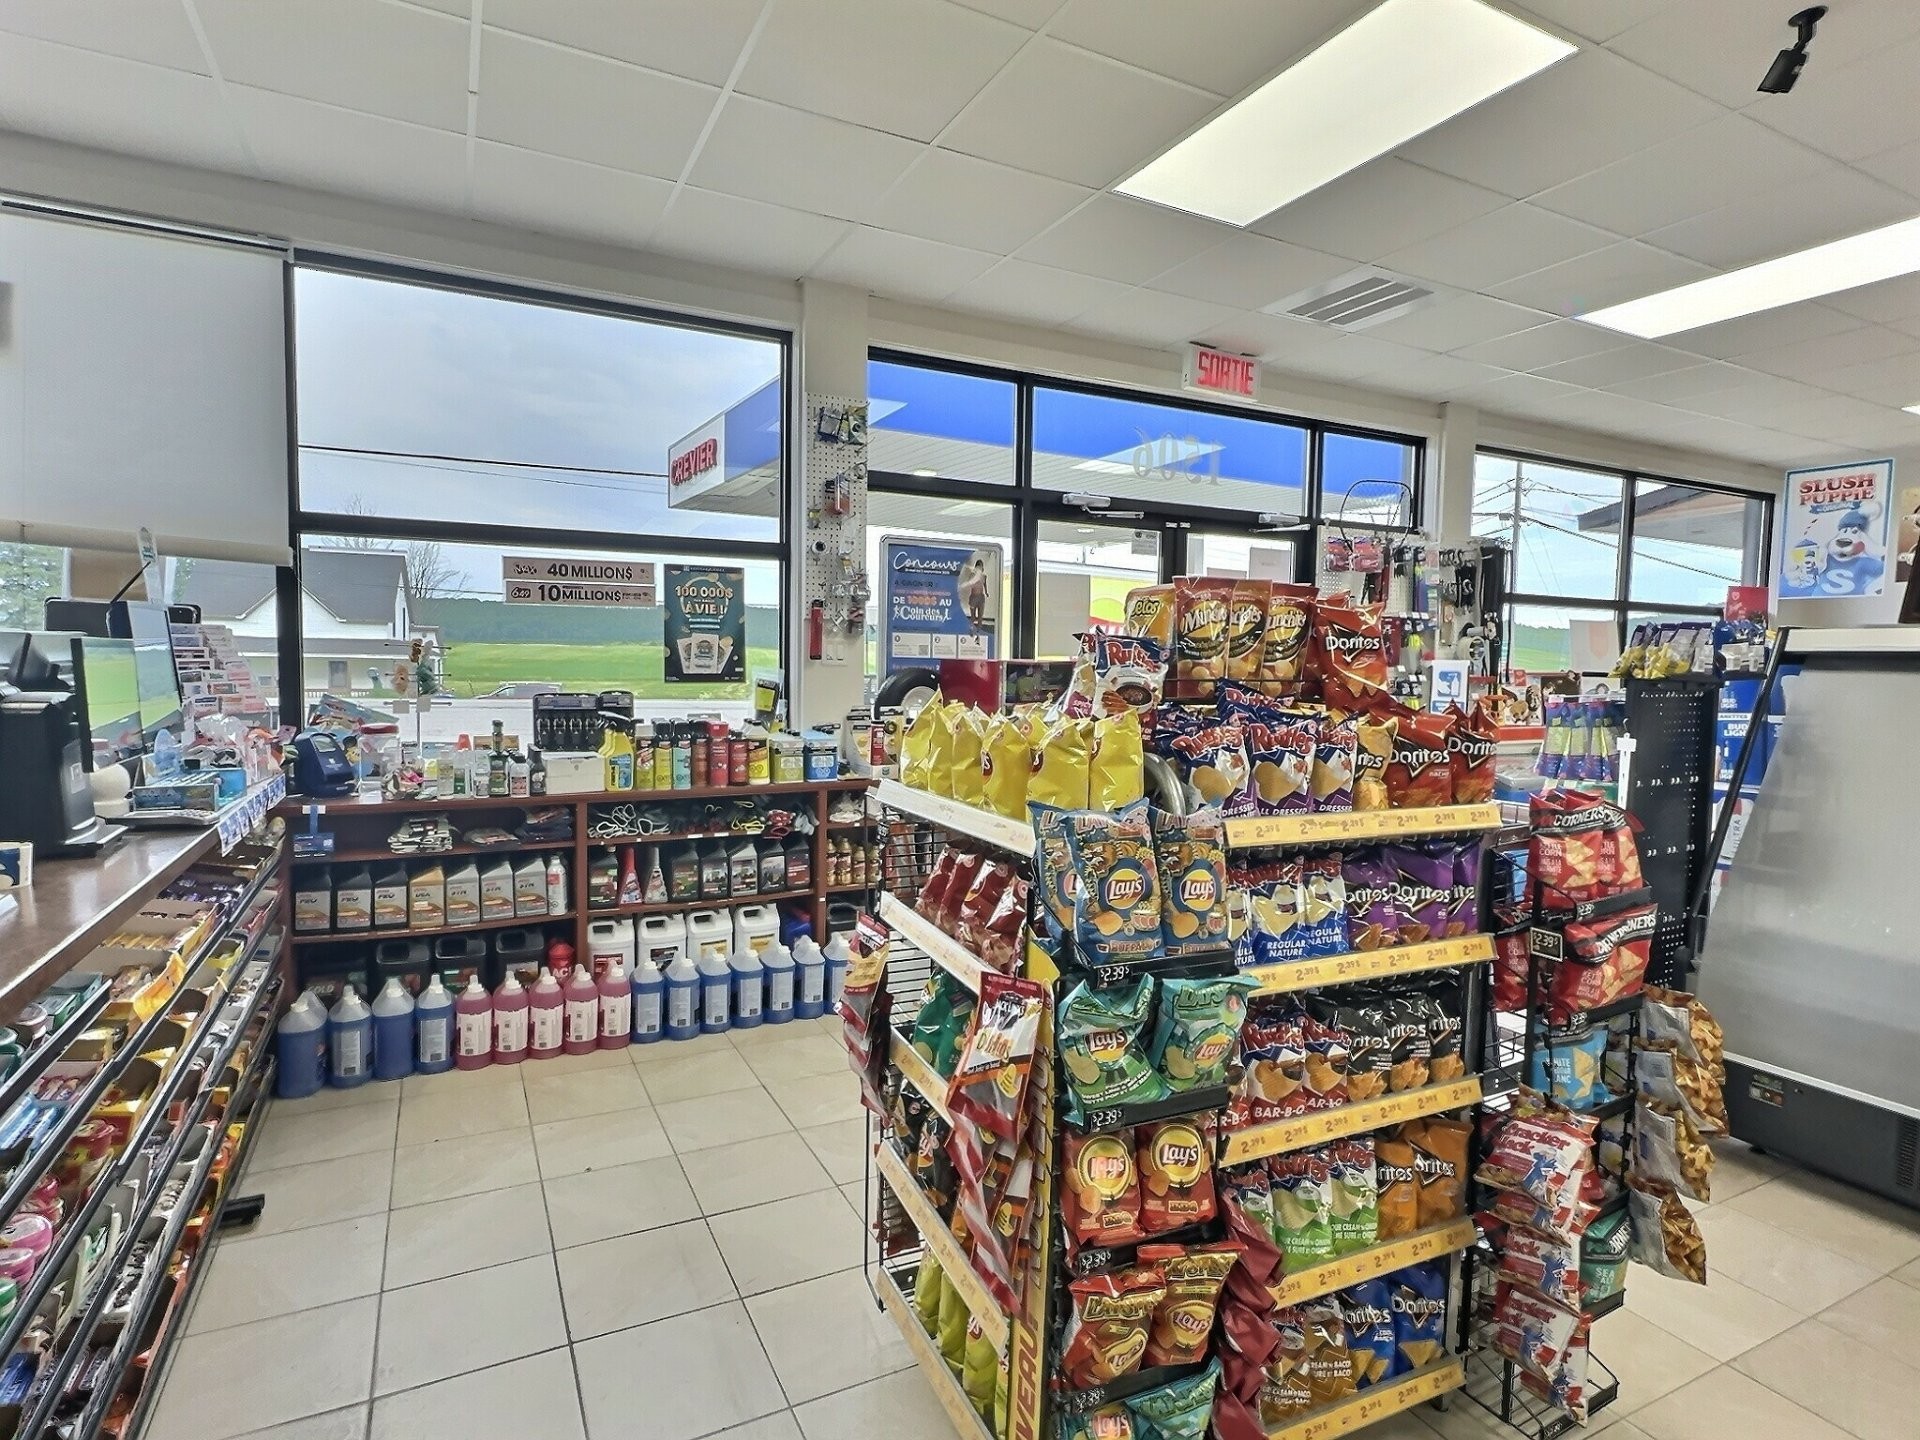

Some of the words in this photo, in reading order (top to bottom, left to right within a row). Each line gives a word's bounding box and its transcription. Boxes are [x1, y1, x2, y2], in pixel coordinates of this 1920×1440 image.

[1197, 351, 1254, 395] SORTIE
[671, 438, 717, 486] CREVIER
[1800, 474, 1876, 494] SLUSH
[1800, 488, 1874, 505] PUPPIE
[893, 551, 960, 571] Concours
[547, 563, 569, 577] 40
[571, 566, 632, 580] MILLION$
[538, 585, 561, 601] 10
[562, 590, 621, 602] MILLION$
[1326, 636, 1380, 650] Doritos
[1250, 723, 1316, 756] Ruffles
[1222, 802, 1255, 817] DRESSED
[1273, 807, 1307, 816] DRESSED
[1553, 806, 1603, 827] CORNERS
[1388, 881, 1450, 903] Doritos
[1267, 940, 1306, 950] REGULAR
[1269, 948, 1303, 957] NATURE
[1255, 1105, 1305, 1118] BAR-B-Q
[1504, 1122, 1571, 1151] Cracker
[1391, 1292, 1446, 1314] Doritos
